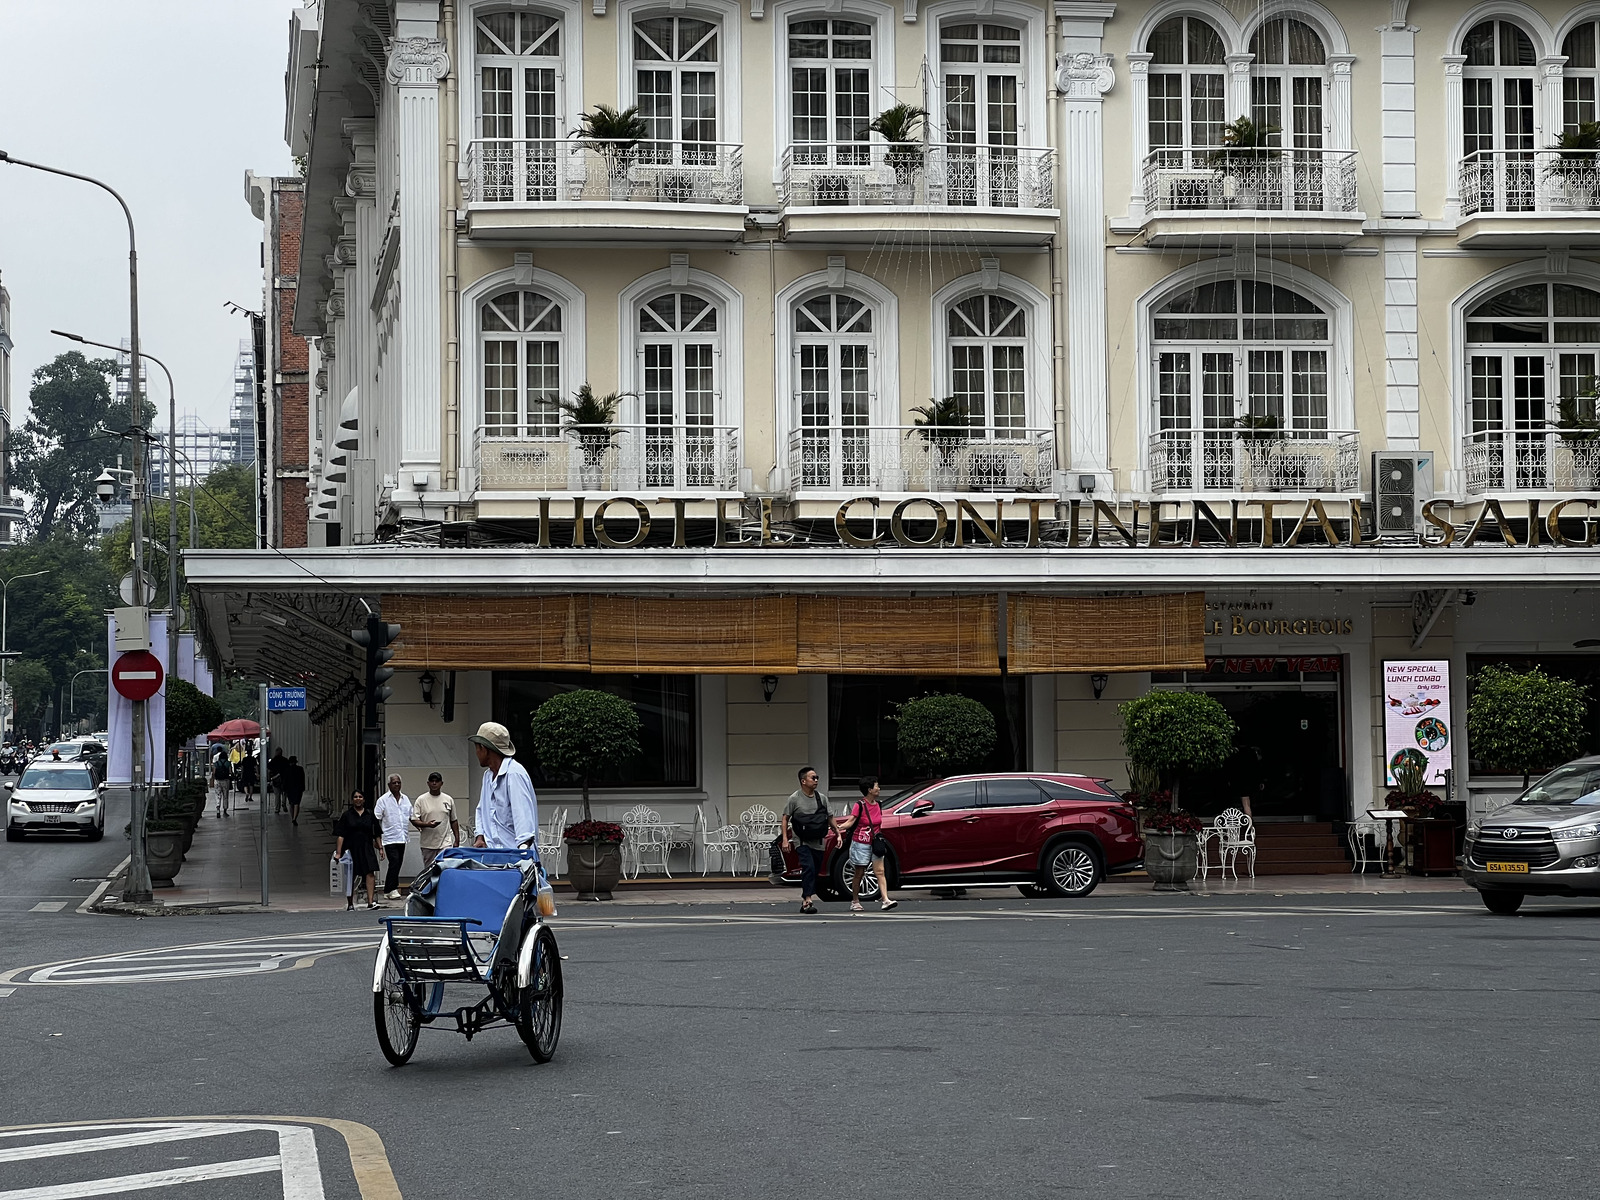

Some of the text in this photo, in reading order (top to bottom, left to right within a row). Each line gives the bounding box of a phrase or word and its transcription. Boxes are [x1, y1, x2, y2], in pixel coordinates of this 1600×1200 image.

[537, 496, 795, 547] HOTEL
[834, 497, 1382, 548] CONTINENTAL
[1231, 615, 1353, 635] BOURGEOIS
[1223, 656, 1278, 673] NEW
[1287, 656, 1342, 673] YEAR
[269, 690, 283, 698] CÔNG
